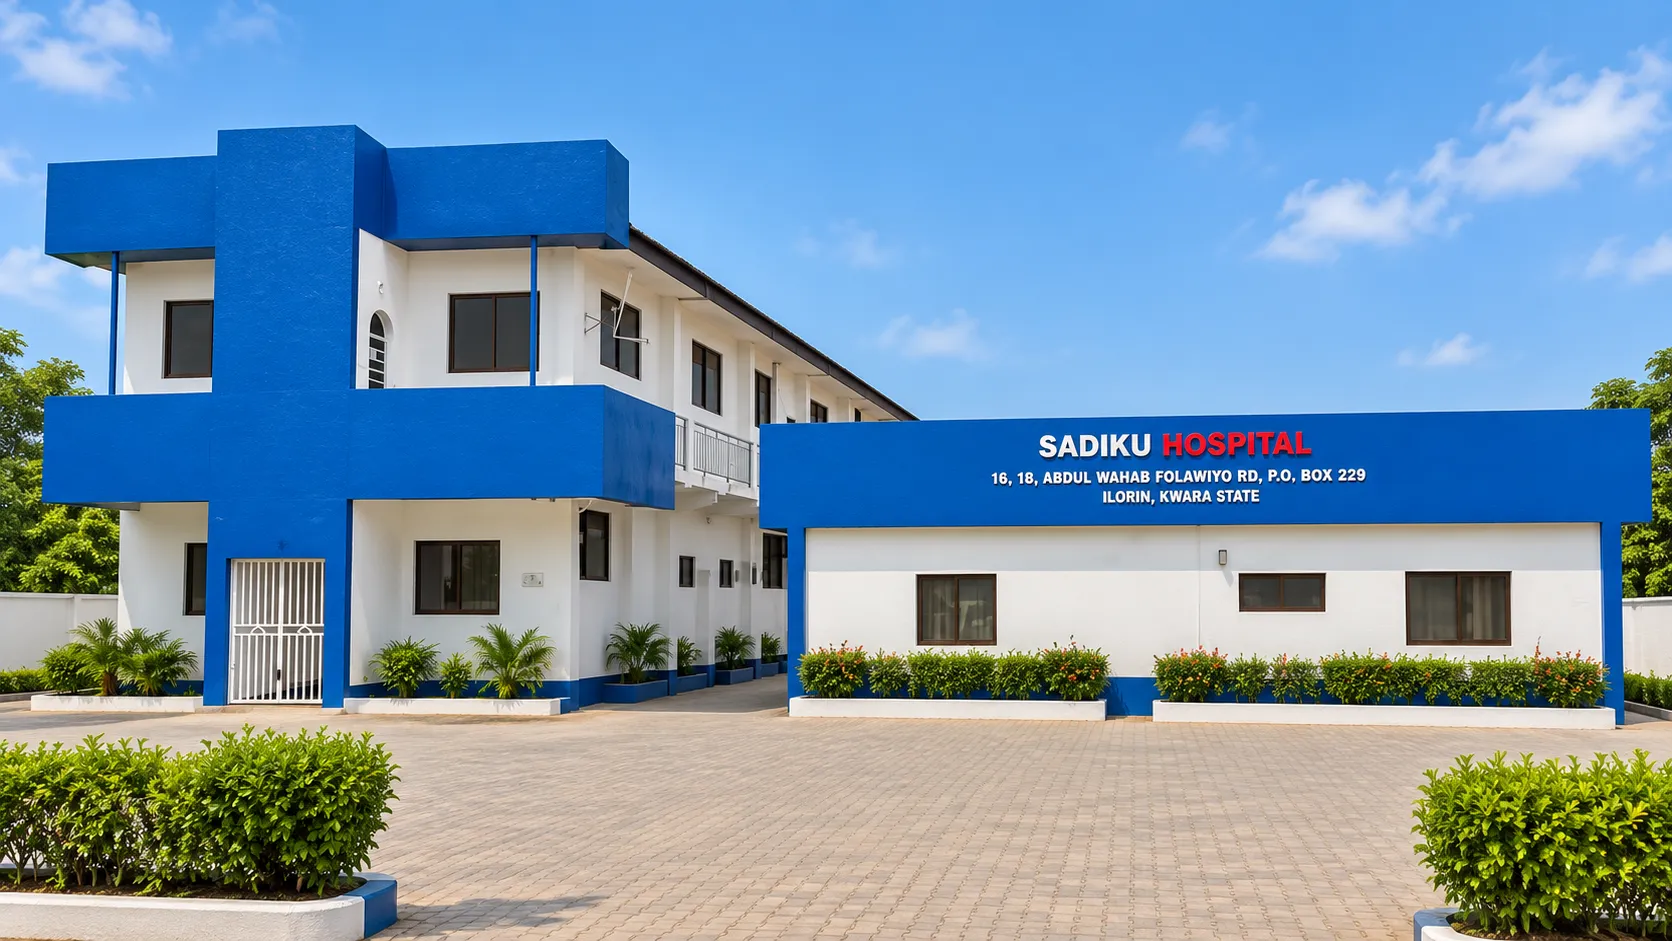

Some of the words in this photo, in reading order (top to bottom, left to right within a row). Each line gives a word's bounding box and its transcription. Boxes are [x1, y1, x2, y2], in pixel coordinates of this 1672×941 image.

[1038, 433, 1151, 458] SADIKU
[1162, 431, 1312, 456] HOSPITAL
[991, 471, 1013, 487] 16,
[1017, 471, 1039, 487] 18,
[1042, 471, 1092, 484] ABDUL
[1095, 470, 1151, 484] WAHAB
[1155, 469, 1233, 483] FOLAWIYO
[1237, 469, 1263, 485] RD,
[1301, 468, 1333, 482] BOX
[1337, 468, 1367, 482] 229
[1102, 490, 1155, 505] ILORIN,
[1159, 490, 1212, 503] KWARA
[1216, 489, 1260, 503] STATE
